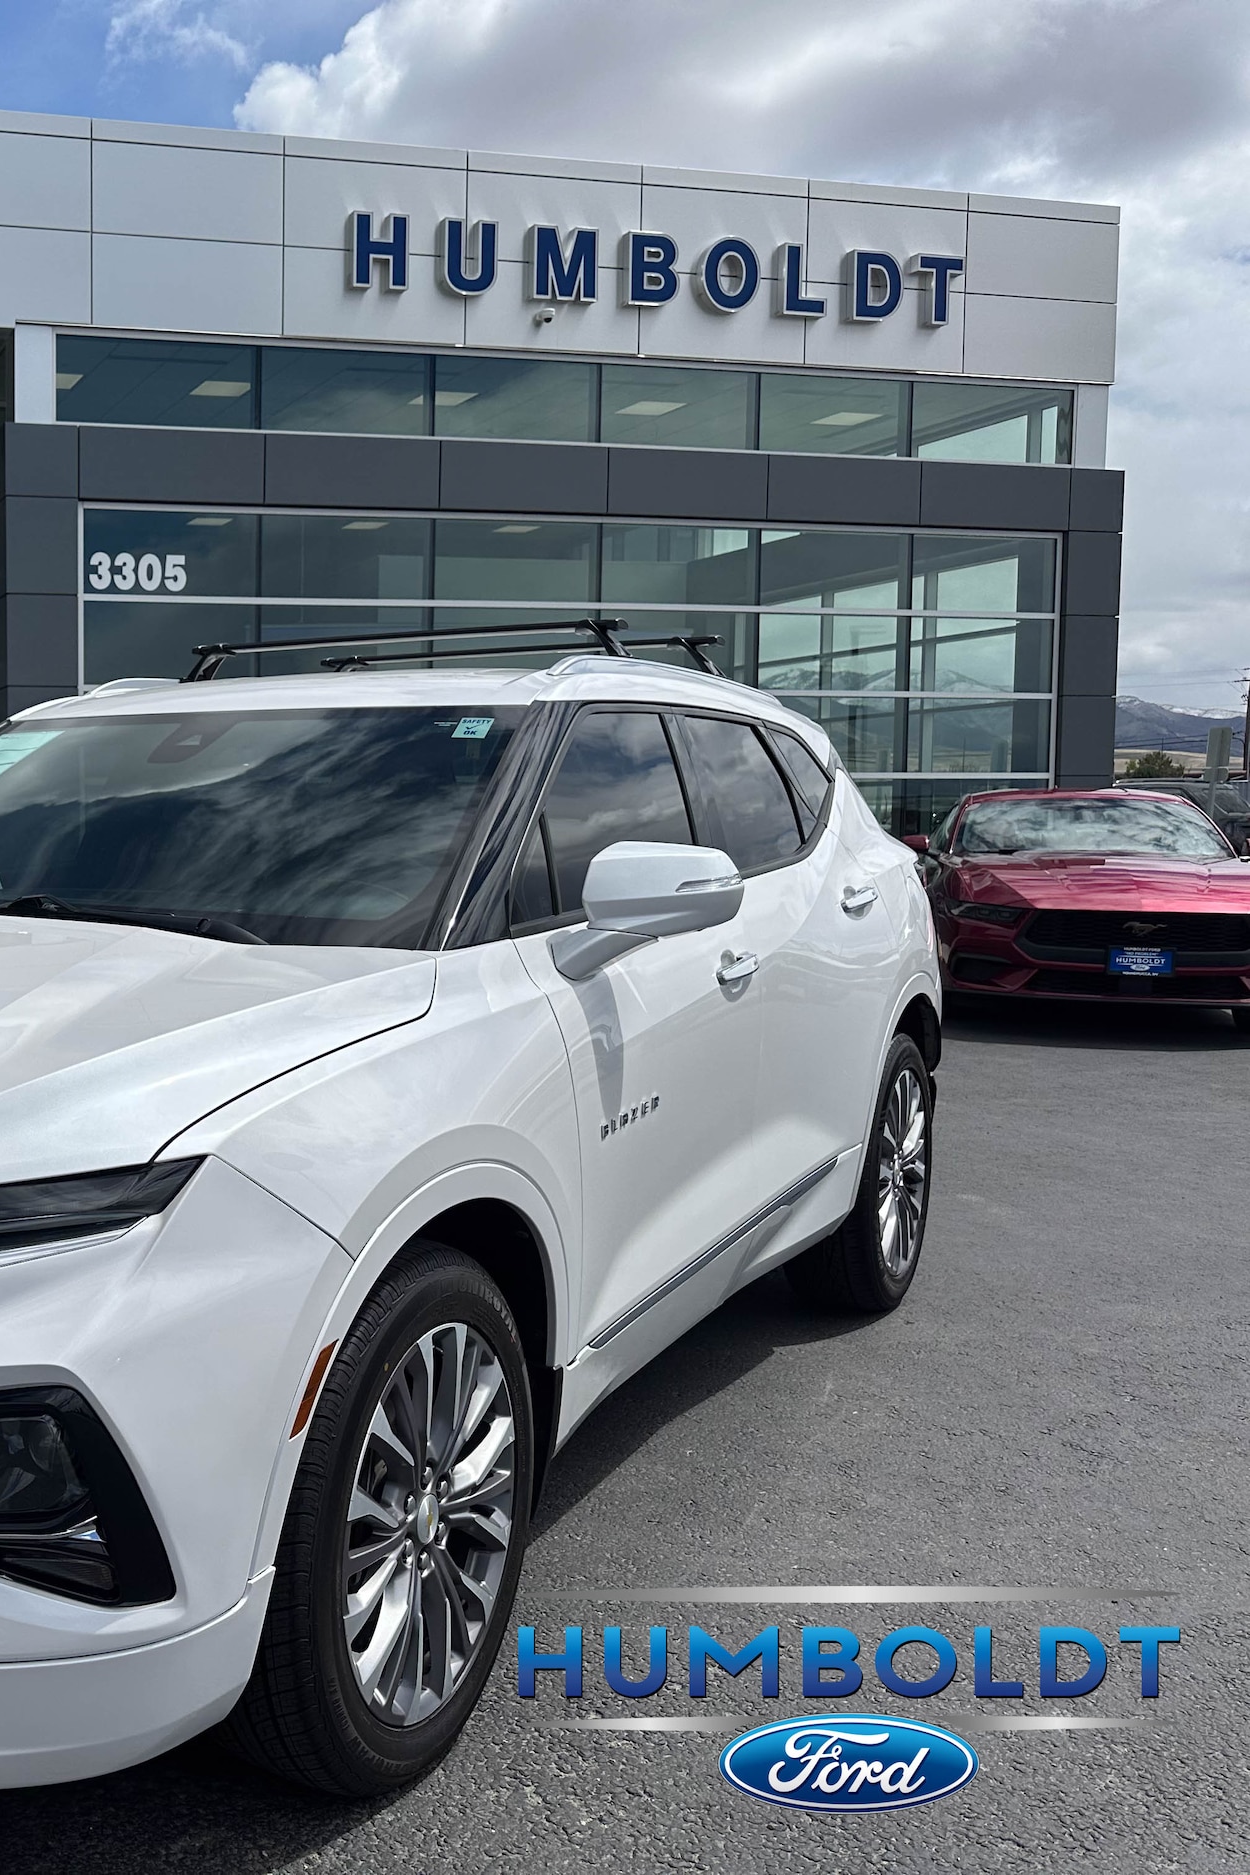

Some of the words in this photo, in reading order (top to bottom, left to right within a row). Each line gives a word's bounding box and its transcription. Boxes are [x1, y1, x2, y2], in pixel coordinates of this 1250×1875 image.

[349, 211, 966, 328] HUMBOLDT
[89, 551, 187, 592] 3305
[600, 1095, 660, 1141] BLAZER
